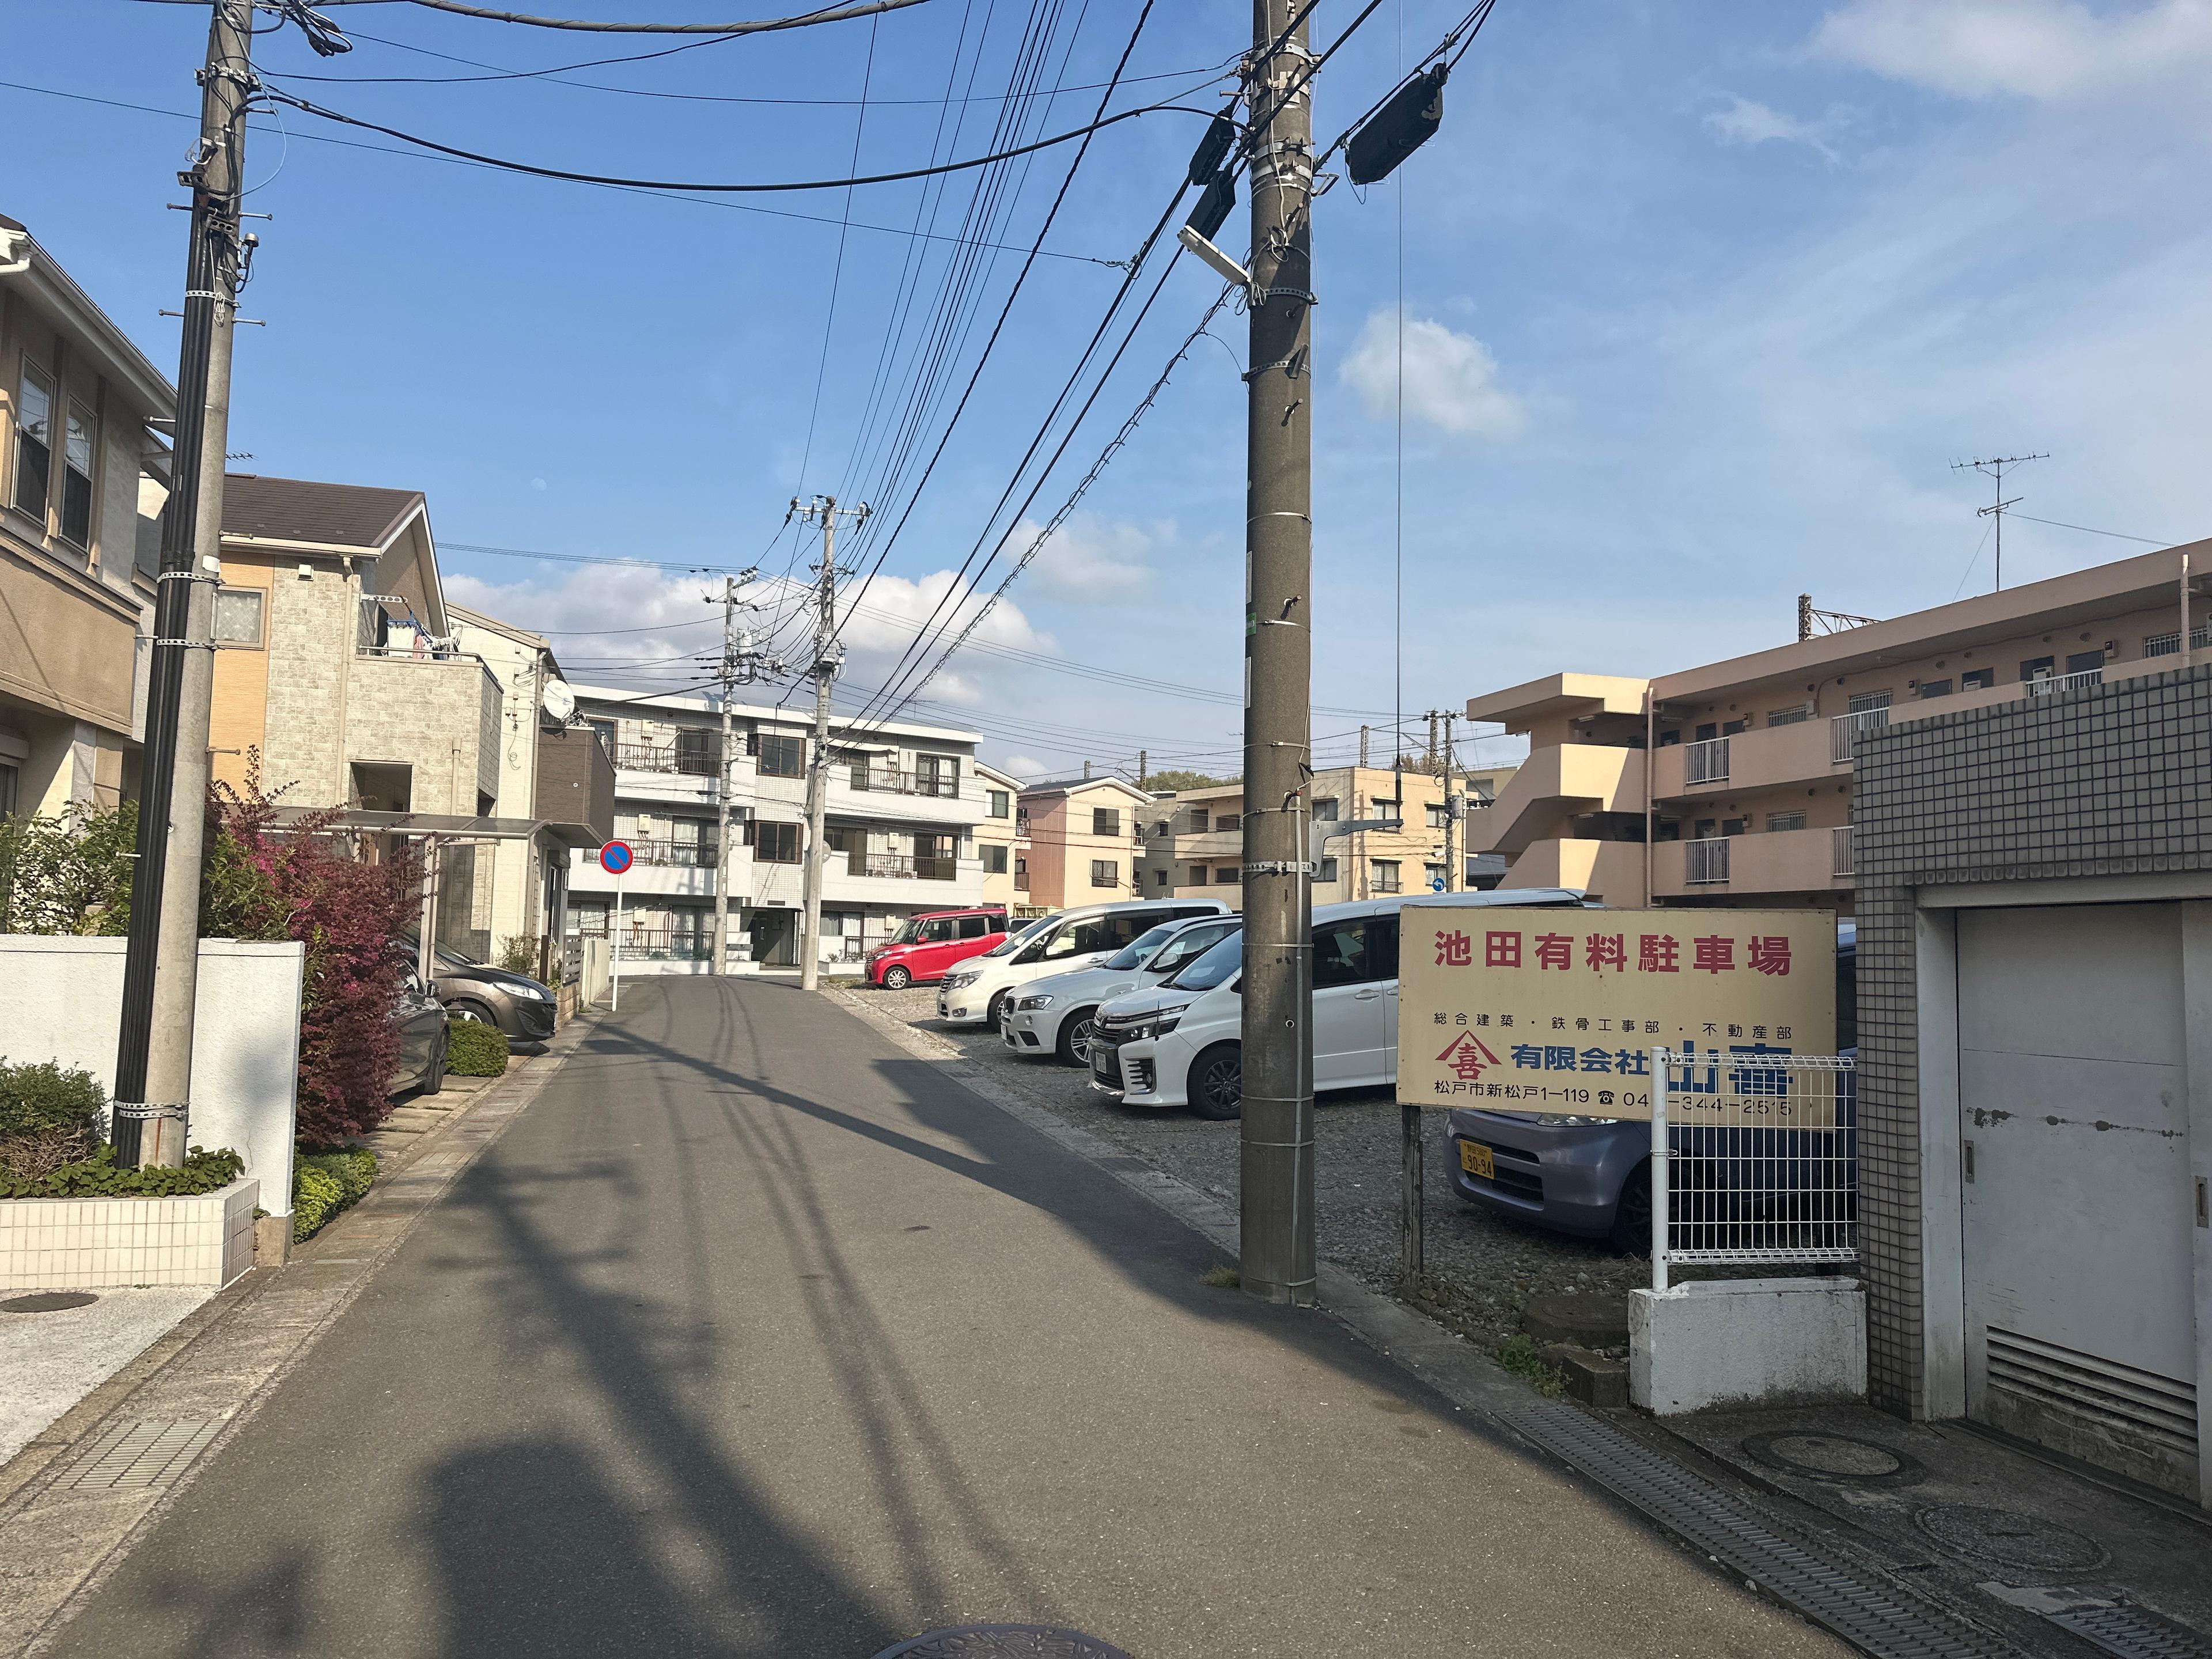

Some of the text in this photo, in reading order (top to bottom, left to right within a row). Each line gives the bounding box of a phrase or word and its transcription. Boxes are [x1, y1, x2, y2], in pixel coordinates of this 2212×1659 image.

[1434, 930, 1792, 976] 池田有料駐車場
[1467, 1154, 1492, 1176] 90-94
